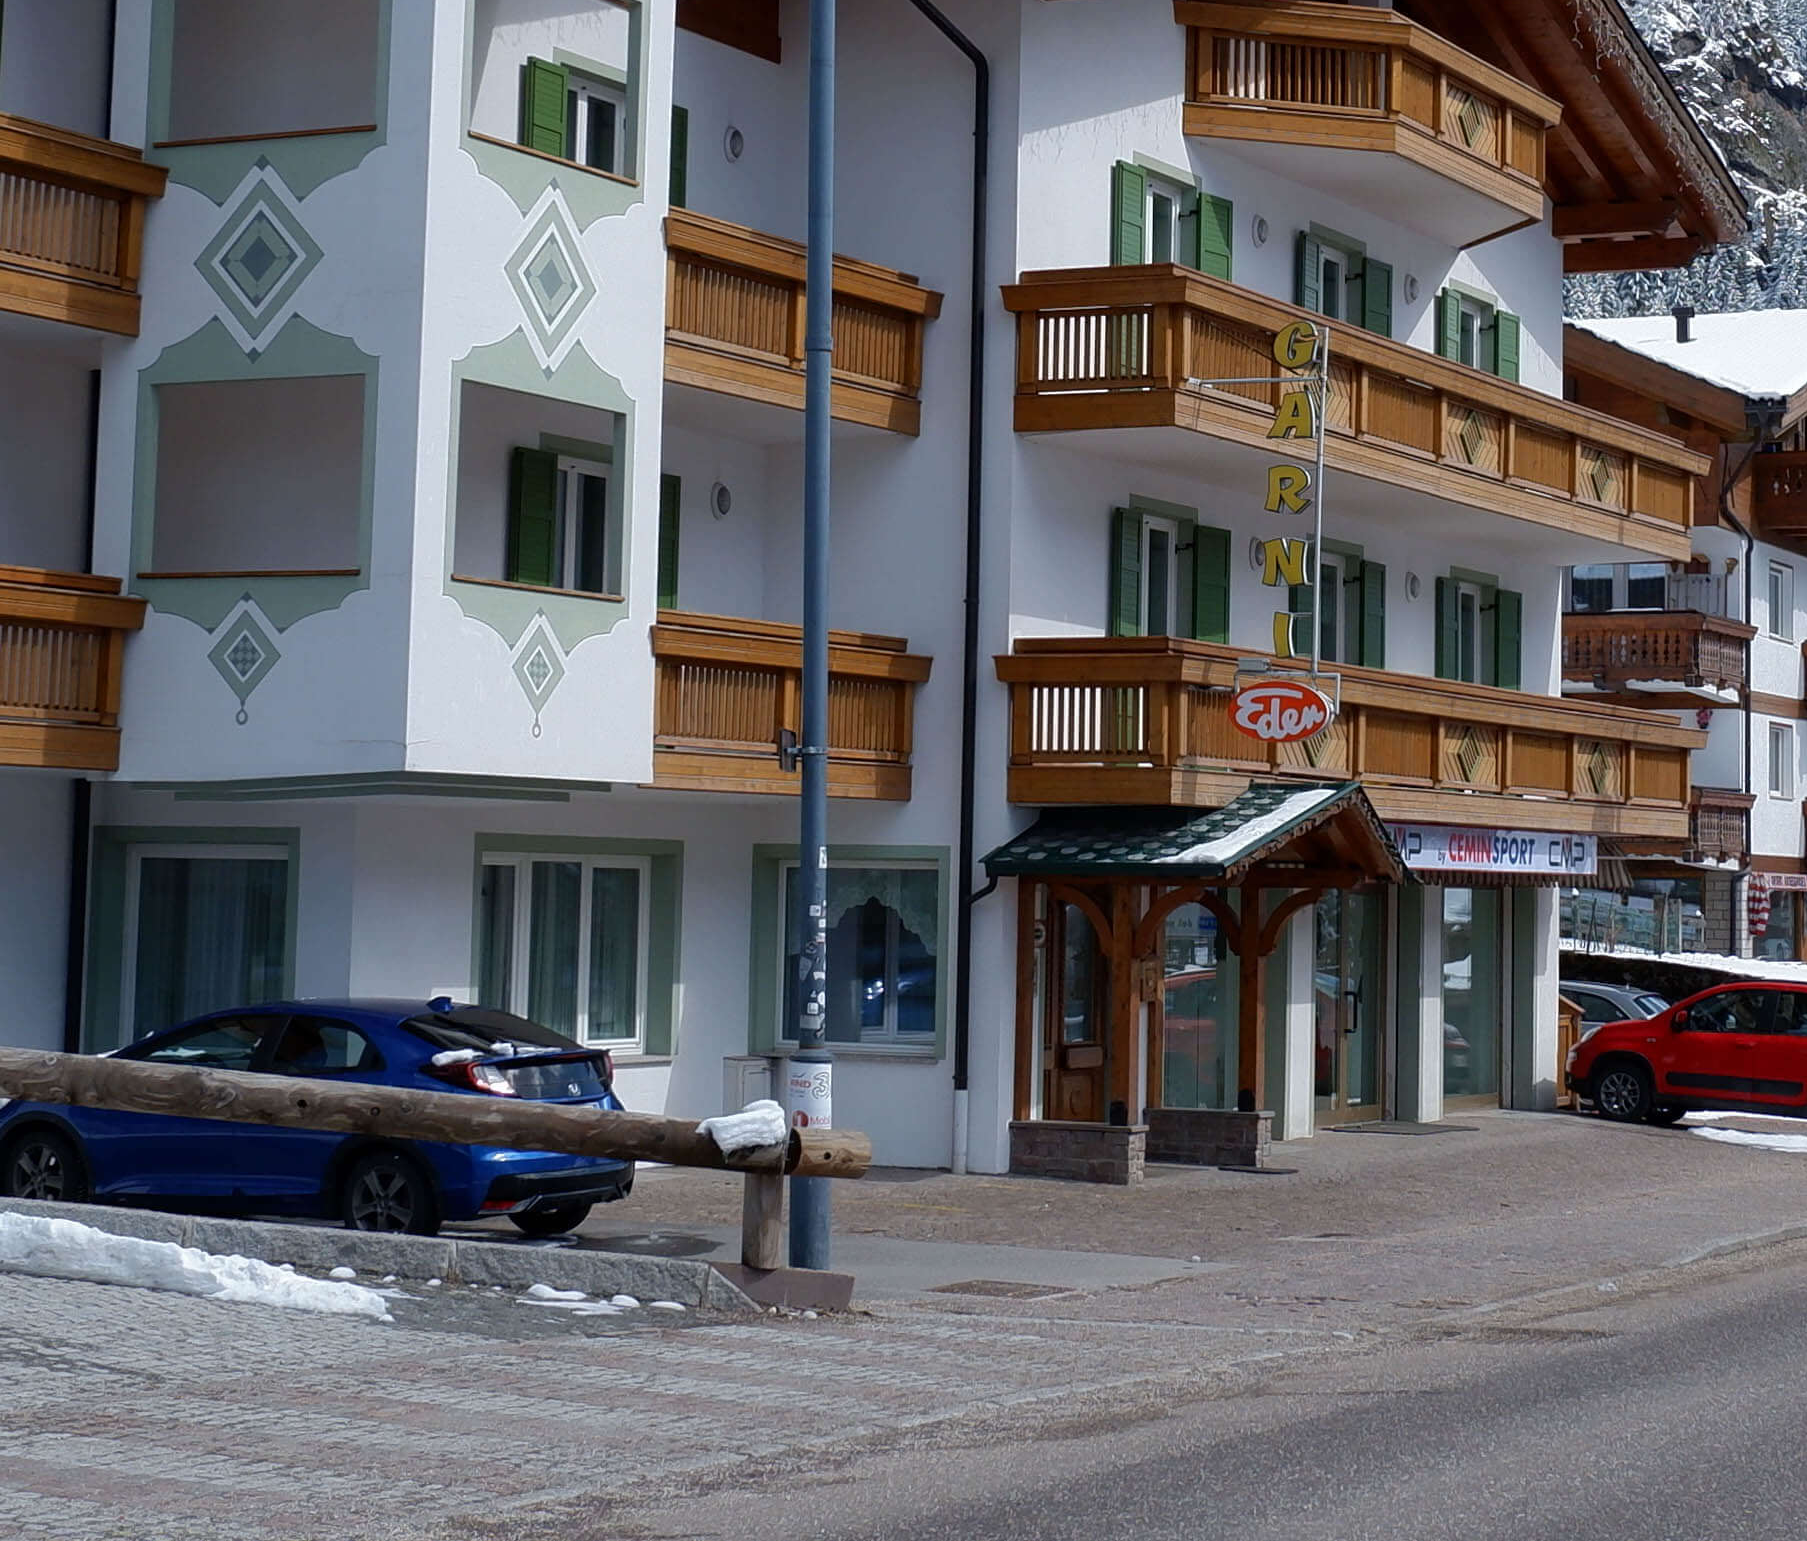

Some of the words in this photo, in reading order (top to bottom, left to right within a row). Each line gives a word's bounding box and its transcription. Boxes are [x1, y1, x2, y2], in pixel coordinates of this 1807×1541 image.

[1261, 320, 1318, 659] GARNI
[1235, 687, 1324, 739] Eden
[1393, 827, 1423, 861] MP
[1548, 836, 1585, 869] CMP
